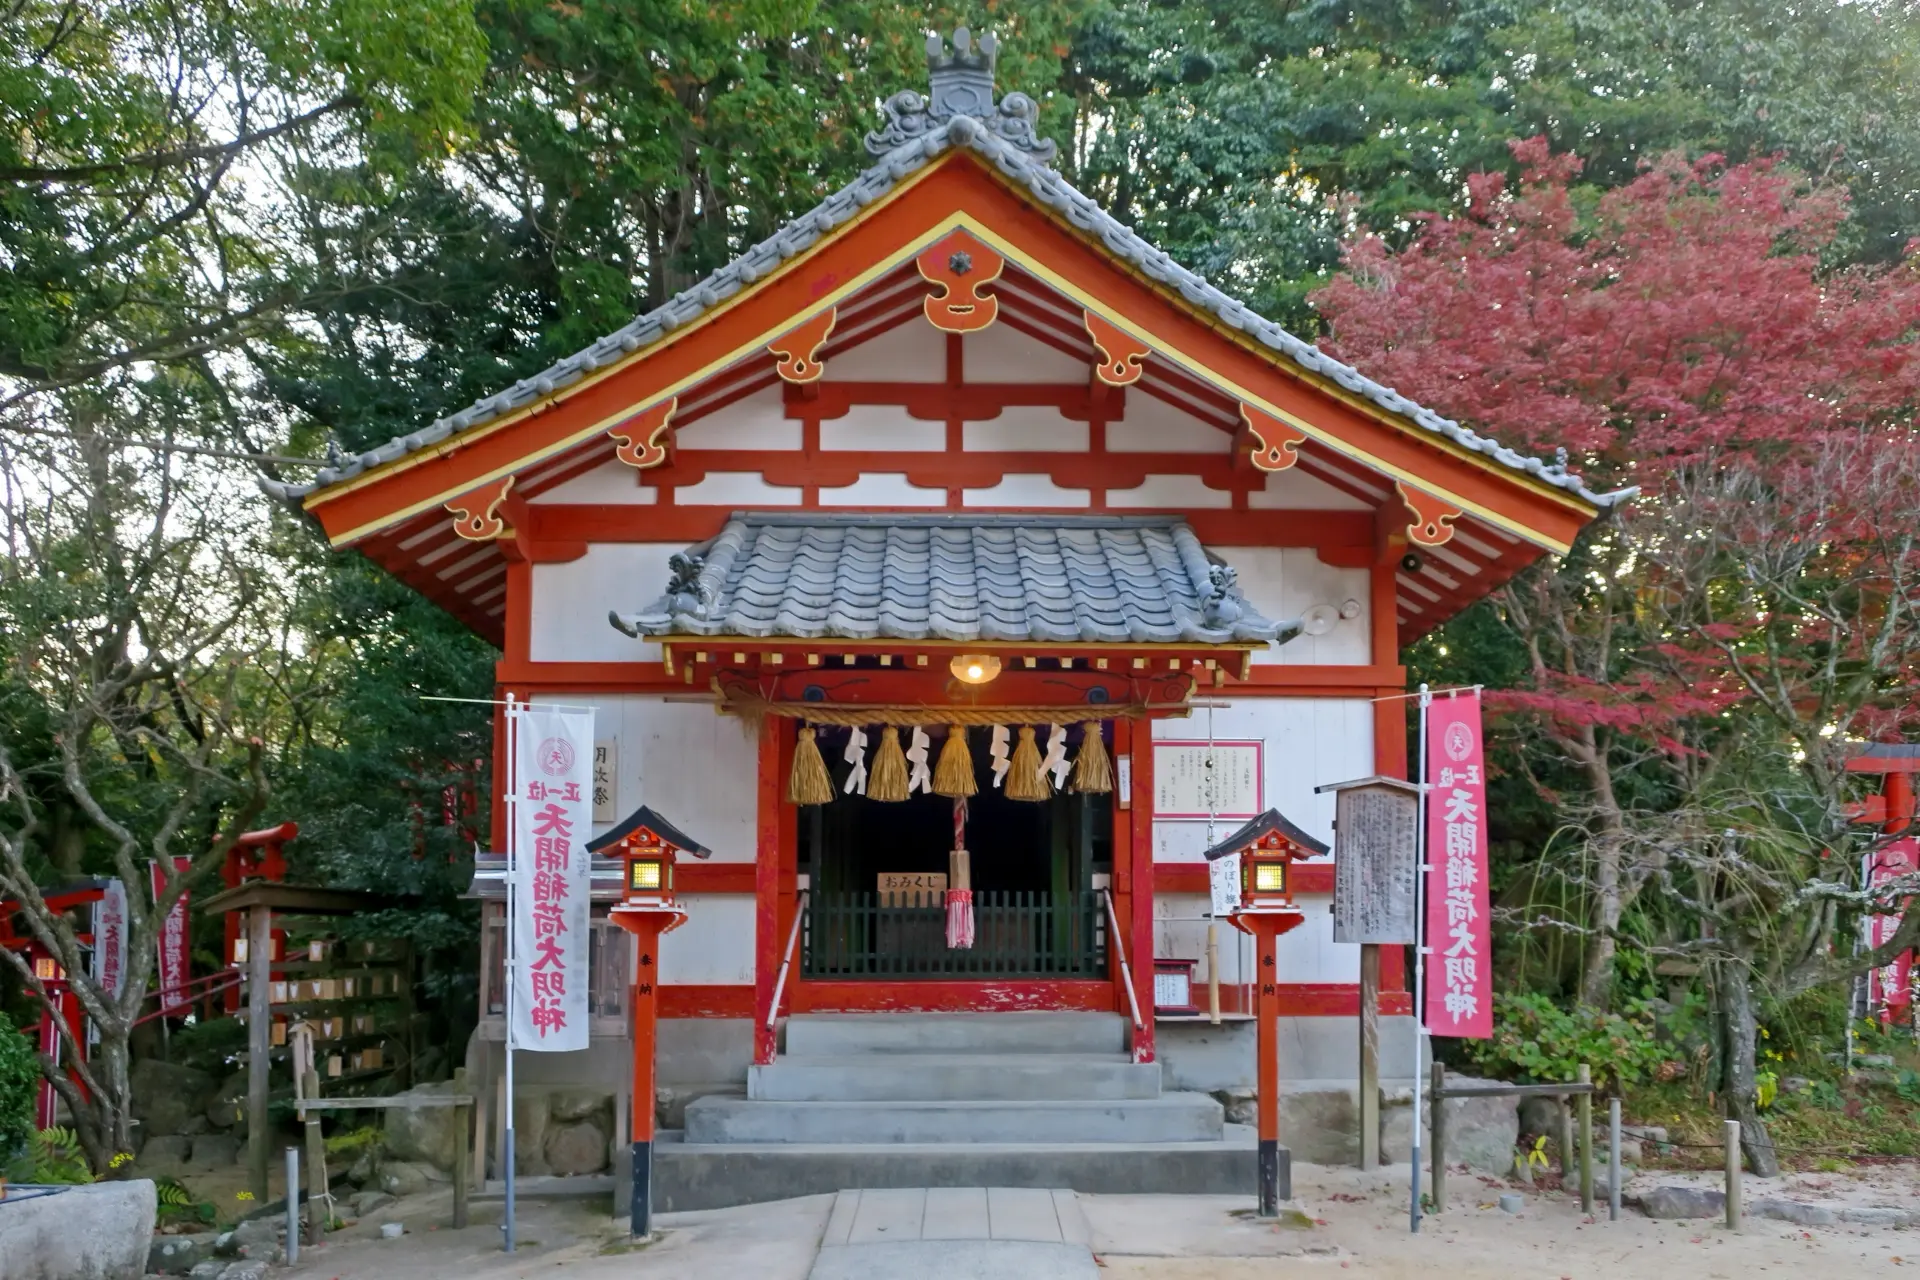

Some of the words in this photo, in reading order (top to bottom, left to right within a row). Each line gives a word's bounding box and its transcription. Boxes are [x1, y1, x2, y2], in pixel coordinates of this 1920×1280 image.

[592, 746, 609, 806] 月次祭
[885, 875, 939, 888] おみくじ
[639, 953, 653, 996] 奉納
[1262, 954, 1275, 996] 奉納
